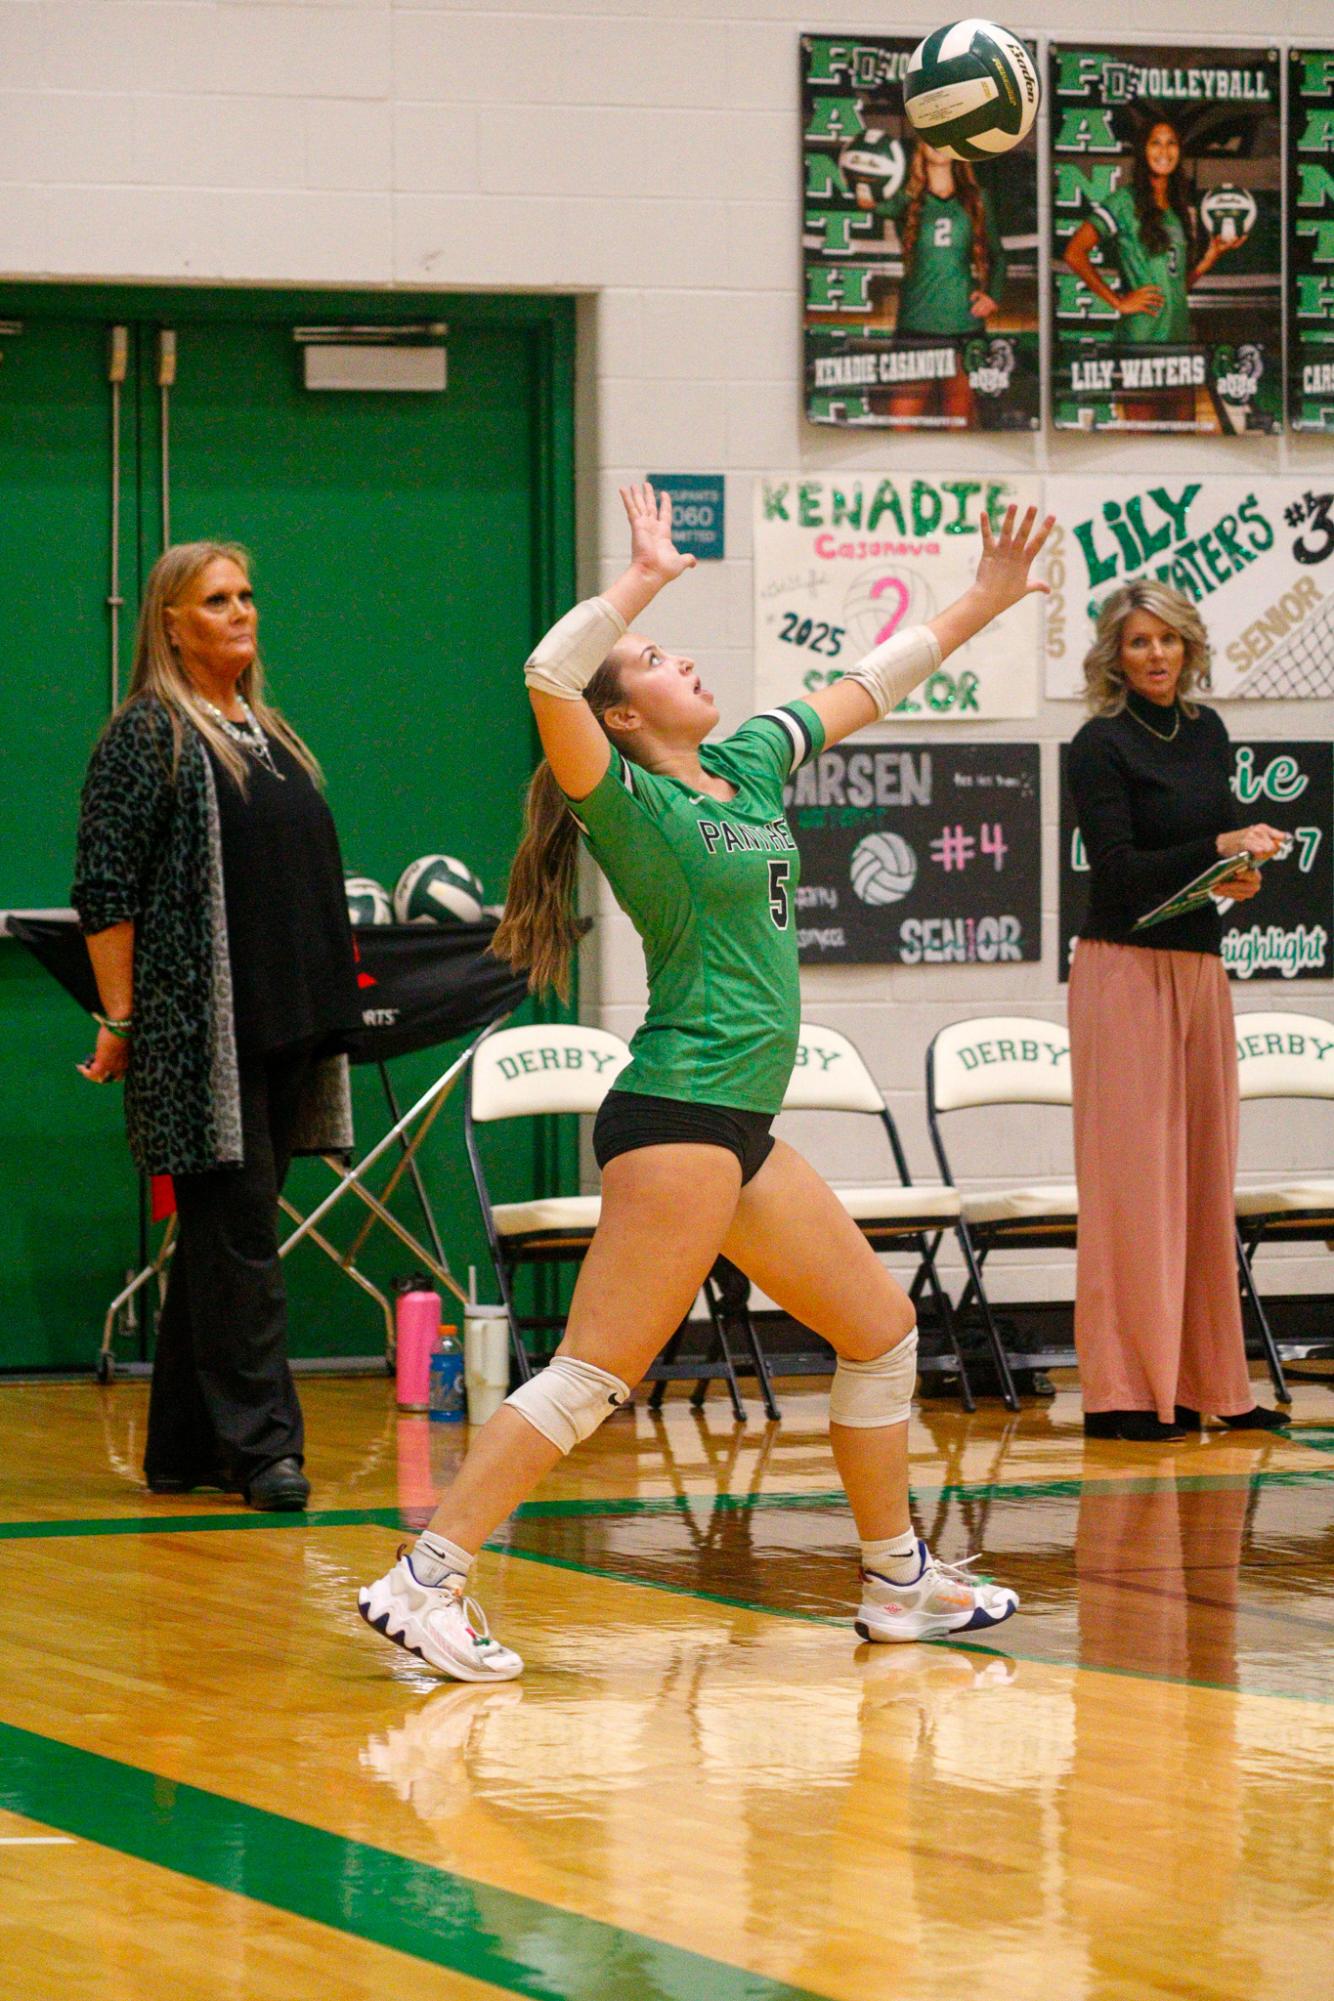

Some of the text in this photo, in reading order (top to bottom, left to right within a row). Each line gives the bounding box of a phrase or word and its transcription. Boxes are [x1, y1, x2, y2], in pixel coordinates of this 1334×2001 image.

[1005, 43, 1036, 104] Baden
[1134, 68, 1270, 101] VOLLEYBALL
[933, 217, 953, 247] 2
[1071, 361, 1114, 391] LILY
[1120, 356, 1206, 389] WATERS
[762, 480, 1017, 536] KENADIE
[1283, 490, 1334, 565] #3
[778, 611, 846, 657] 2025
[929, 822, 1008, 872] #4
[766, 859, 790, 931] 5
[1220, 925, 1328, 979] ighlight
[496, 1047, 617, 1081] DERBY
[956, 1038, 1070, 1072] DERBY
